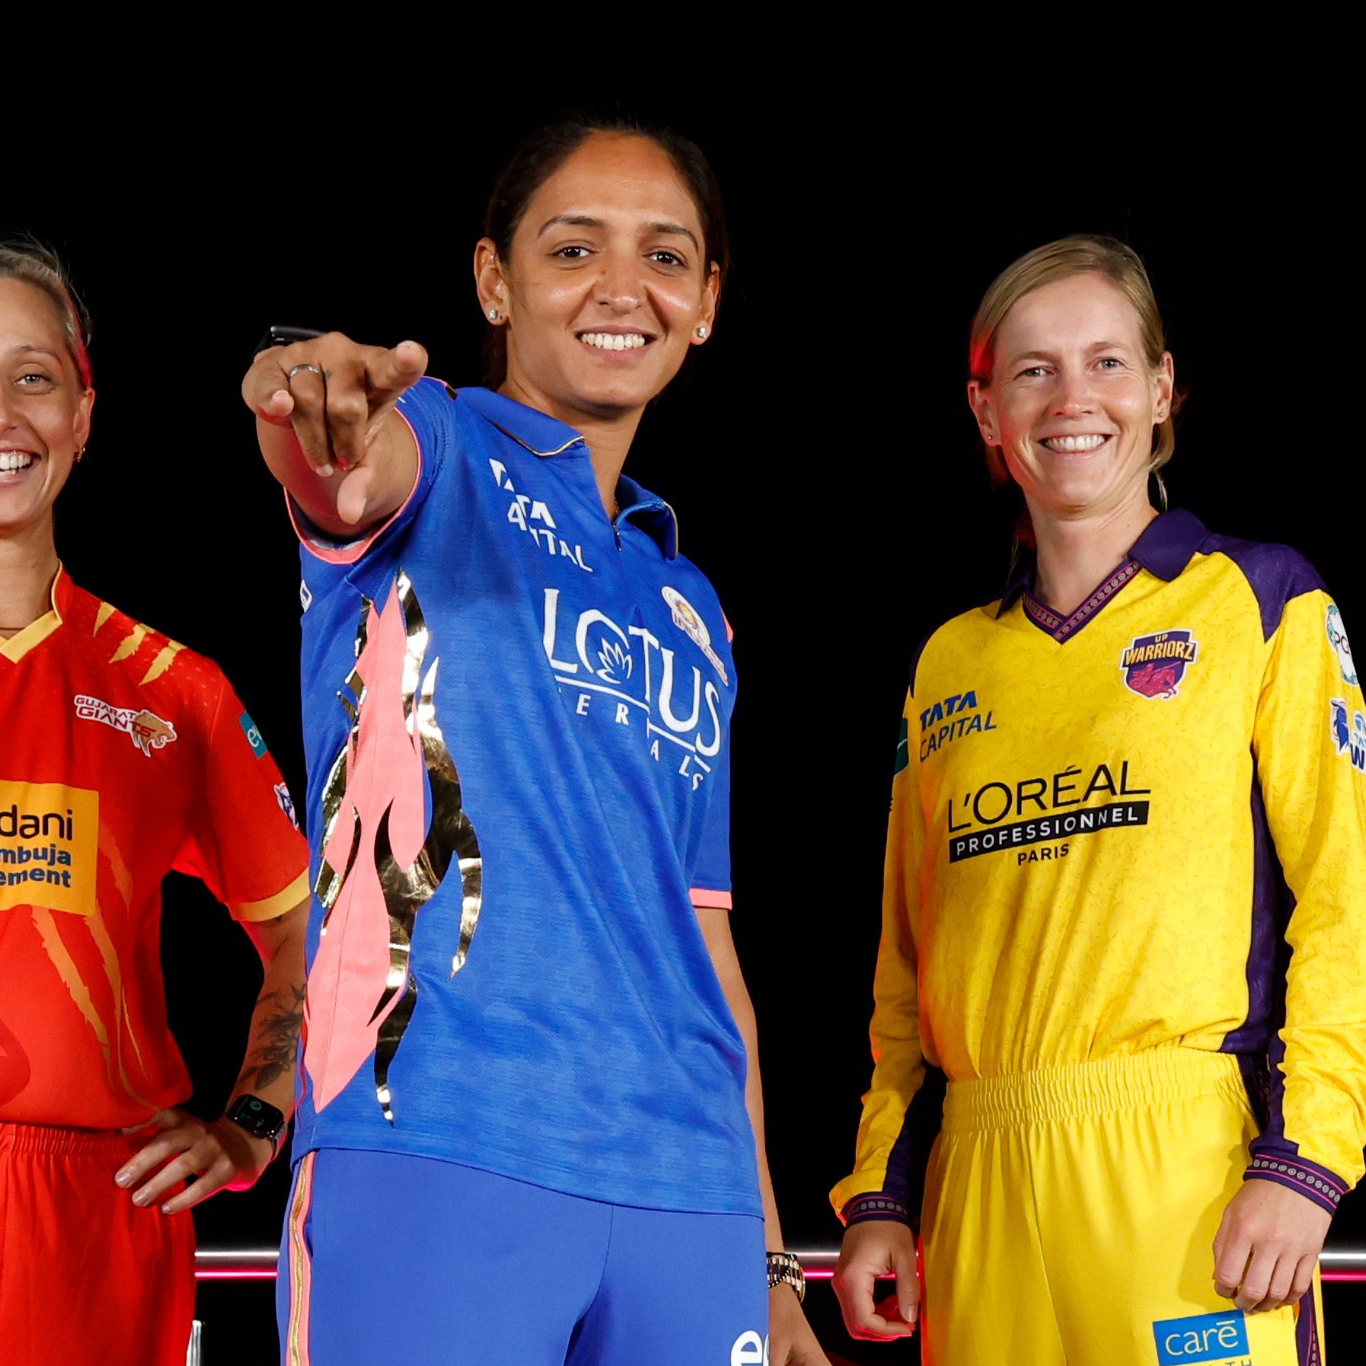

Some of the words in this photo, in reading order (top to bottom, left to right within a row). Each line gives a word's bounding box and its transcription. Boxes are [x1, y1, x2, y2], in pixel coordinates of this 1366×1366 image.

[1125, 640, 1195, 667] WARRIORZ
[1154, 633, 1169, 643] UP
[542, 587, 721, 757] LOTUS
[75, 696, 137, 720] GUJARAT
[77, 705, 157, 738] GIANTS
[919, 689, 978, 733] TATA
[919, 710, 997, 763] CAPITAL
[947, 760, 1152, 834] L'ORÉAL
[955, 805, 1139, 857] PROFESSIONNEL
[1016, 843, 1070, 867] PARIS
